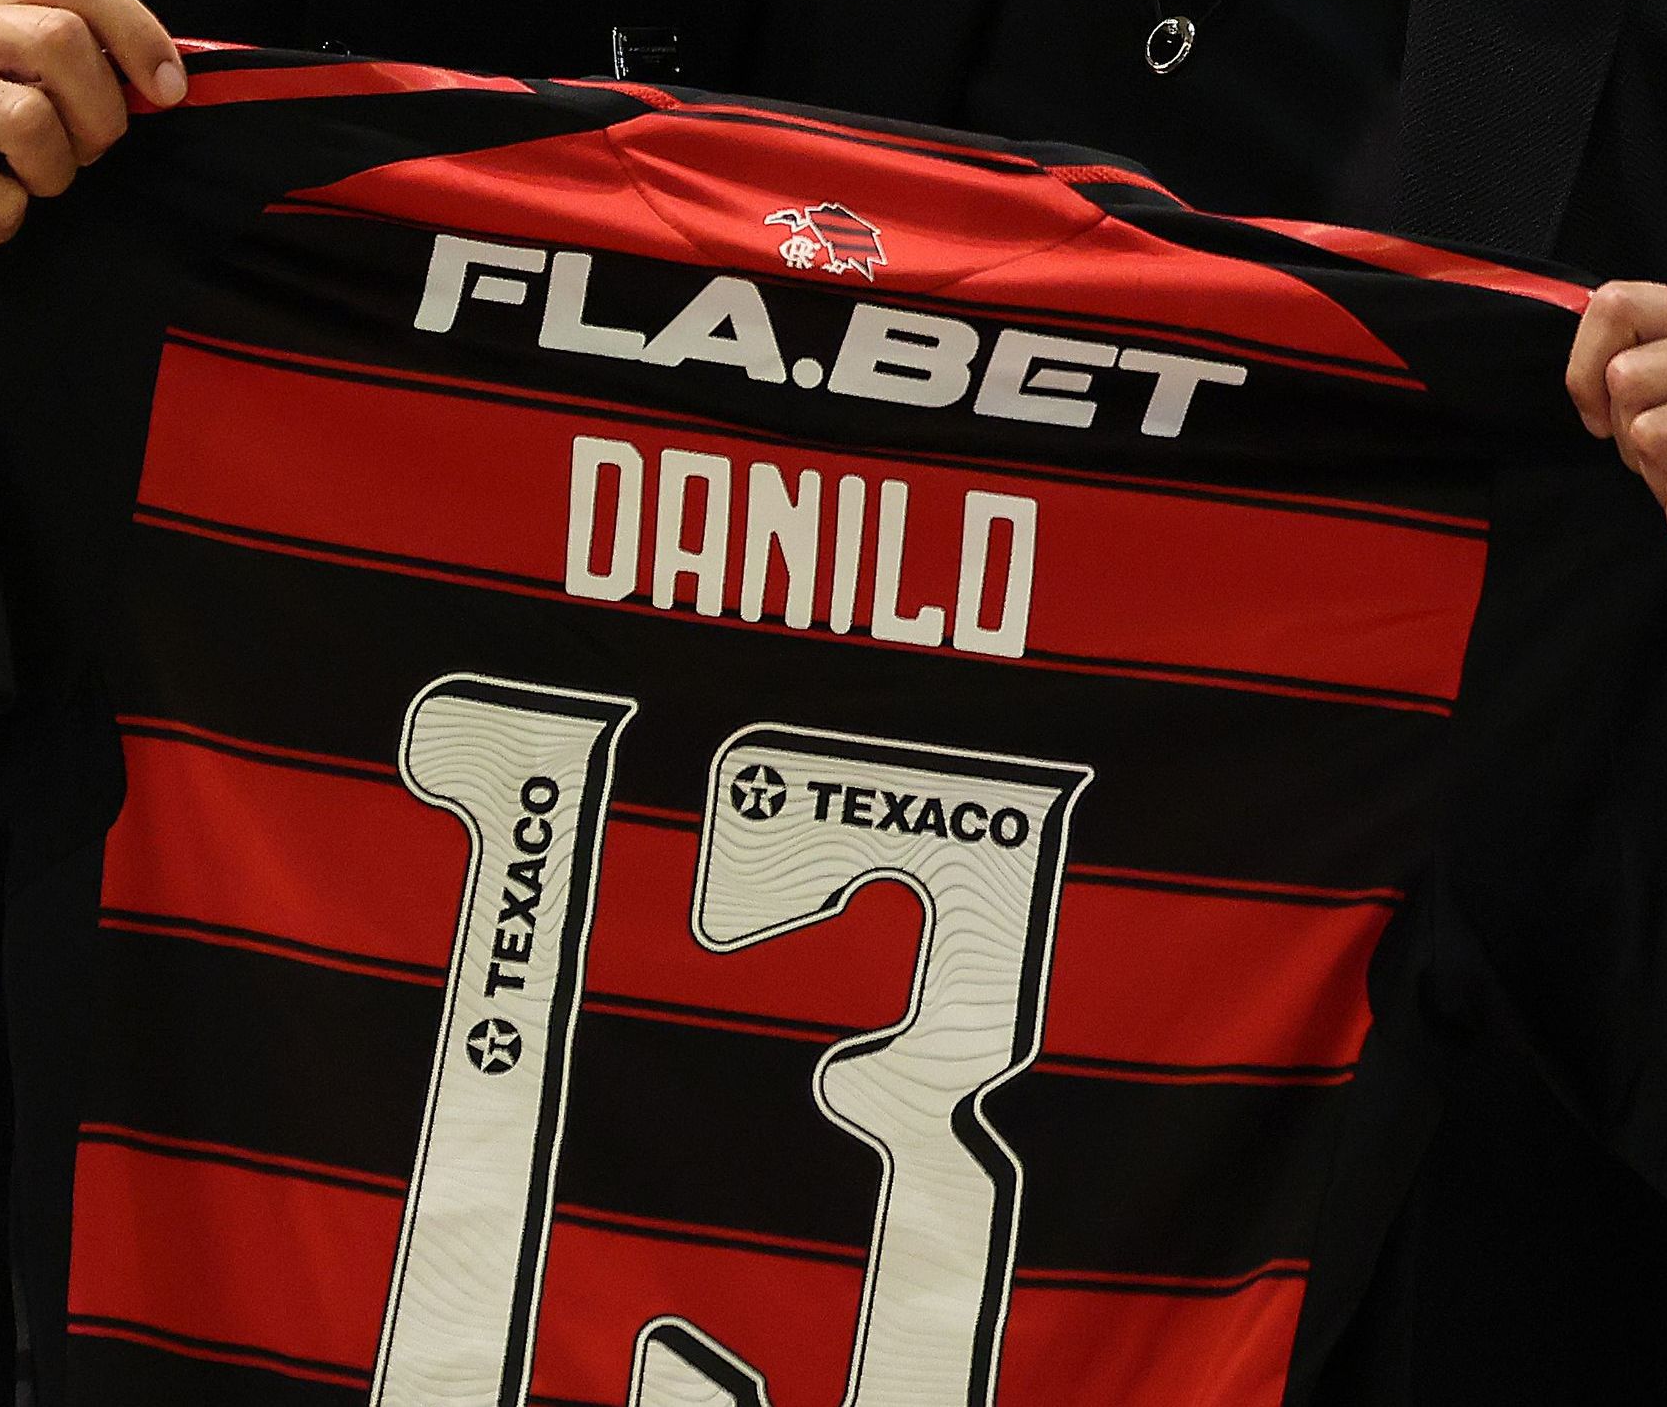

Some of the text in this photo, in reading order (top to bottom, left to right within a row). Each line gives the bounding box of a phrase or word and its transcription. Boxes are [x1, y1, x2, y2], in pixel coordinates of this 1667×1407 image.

[414, 234, 1247, 441] FLA.BET
[564, 435, 1038, 661] DANILO
[482, 775, 560, 999] TEXACO
[806, 779, 1031, 848] TEXACO
